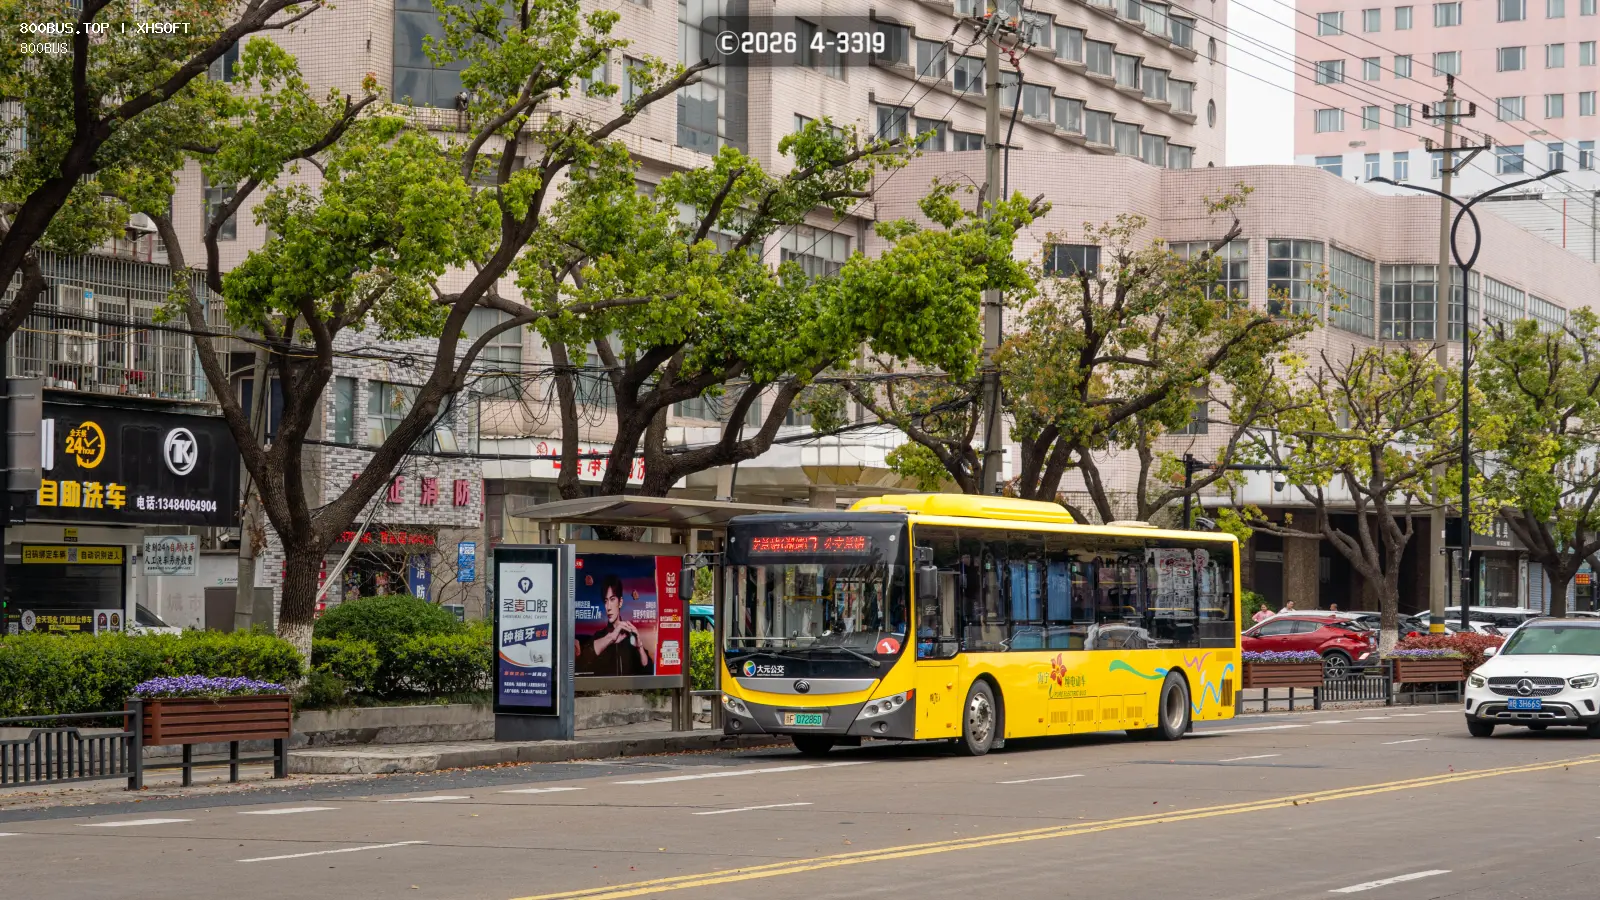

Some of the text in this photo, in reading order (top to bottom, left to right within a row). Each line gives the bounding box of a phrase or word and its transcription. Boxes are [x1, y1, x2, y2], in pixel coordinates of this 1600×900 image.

[38, 479, 127, 510] 自助洗车
[136, 496, 217, 512] 电话:13484064904
[503, 628, 535, 643] 种植牙
[756, 664, 785, 674] 大元公交
